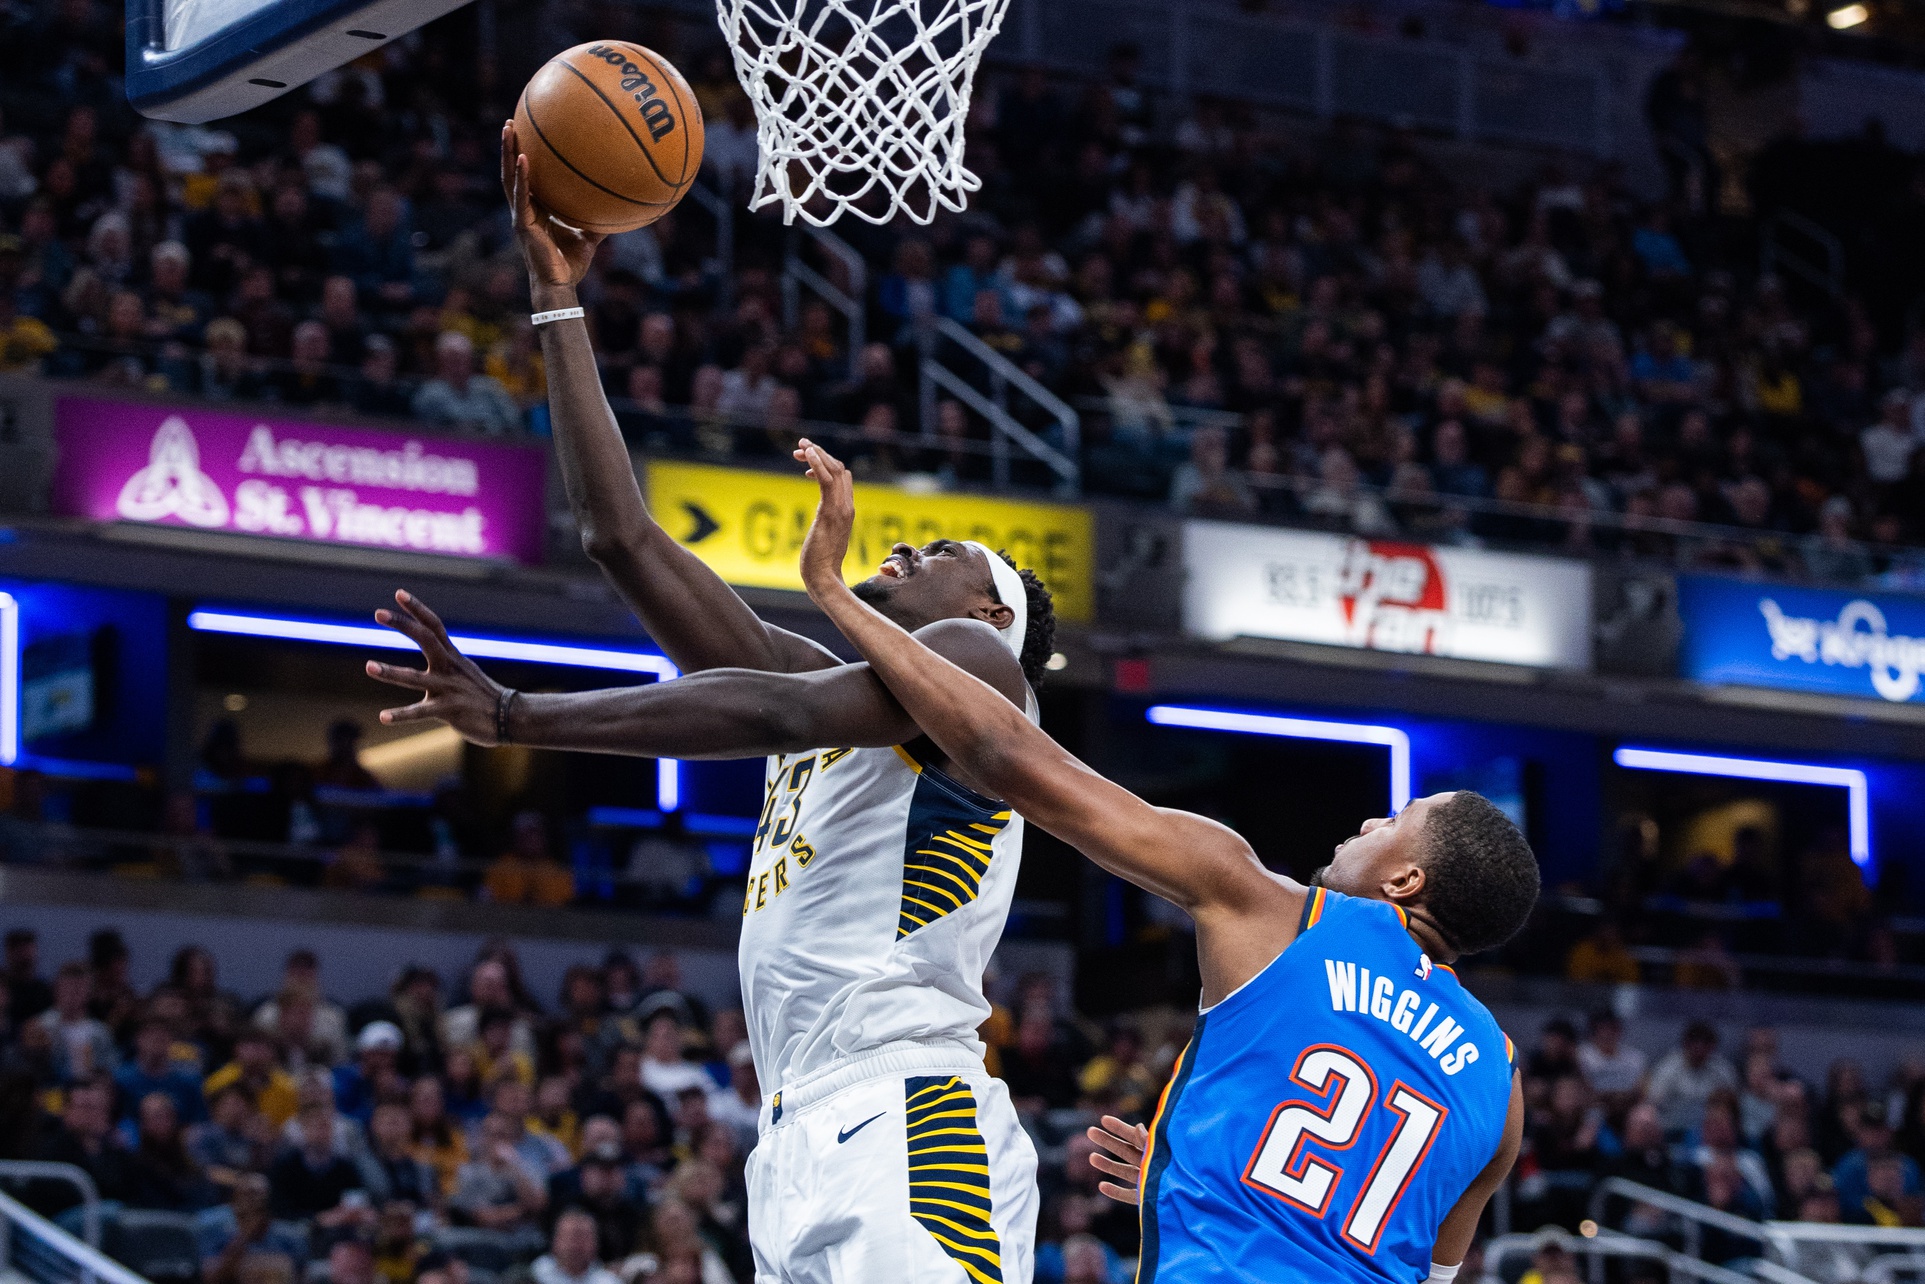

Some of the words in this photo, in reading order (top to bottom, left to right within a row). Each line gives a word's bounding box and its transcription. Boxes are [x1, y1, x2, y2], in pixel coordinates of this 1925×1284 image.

[586, 44, 676, 145] Wilson
[239, 424, 479, 497] Ascension
[234, 479, 302, 535] St.
[302, 485, 484, 554] Vincent
[742, 500, 1074, 595] GANBGE
[753, 754, 817, 855] 43
[1325, 959, 1479, 1076] WIGGINS
[1240, 1043, 1449, 1256] 21
